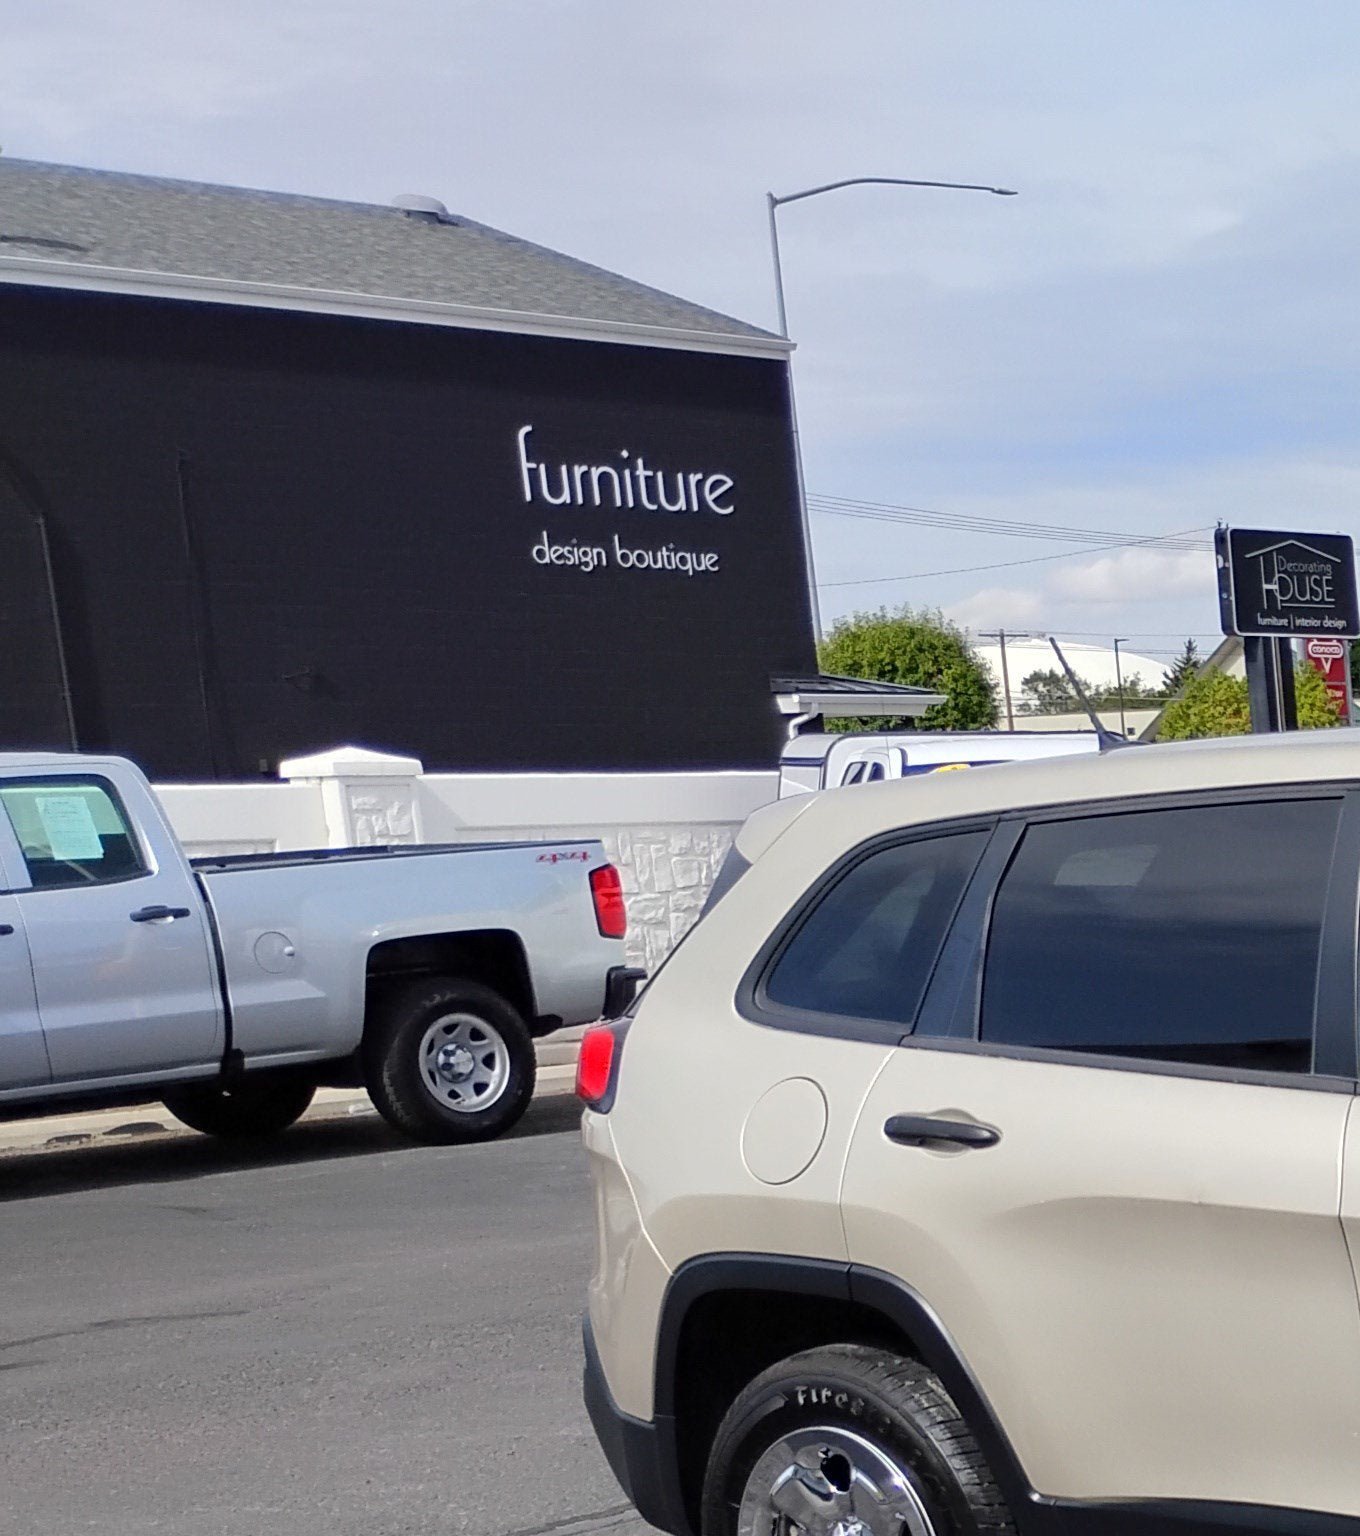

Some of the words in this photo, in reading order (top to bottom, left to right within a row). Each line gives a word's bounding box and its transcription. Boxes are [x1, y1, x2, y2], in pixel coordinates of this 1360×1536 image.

[518, 424, 735, 515] furniture
[532, 530, 607, 572] design
[612, 533, 720, 576] boutique
[1278, 555, 1332, 576] Decorating
[1260, 551, 1335, 610] HOUSE
[1258, 612, 1289, 627] furniture
[1322, 615, 1347, 630] design
